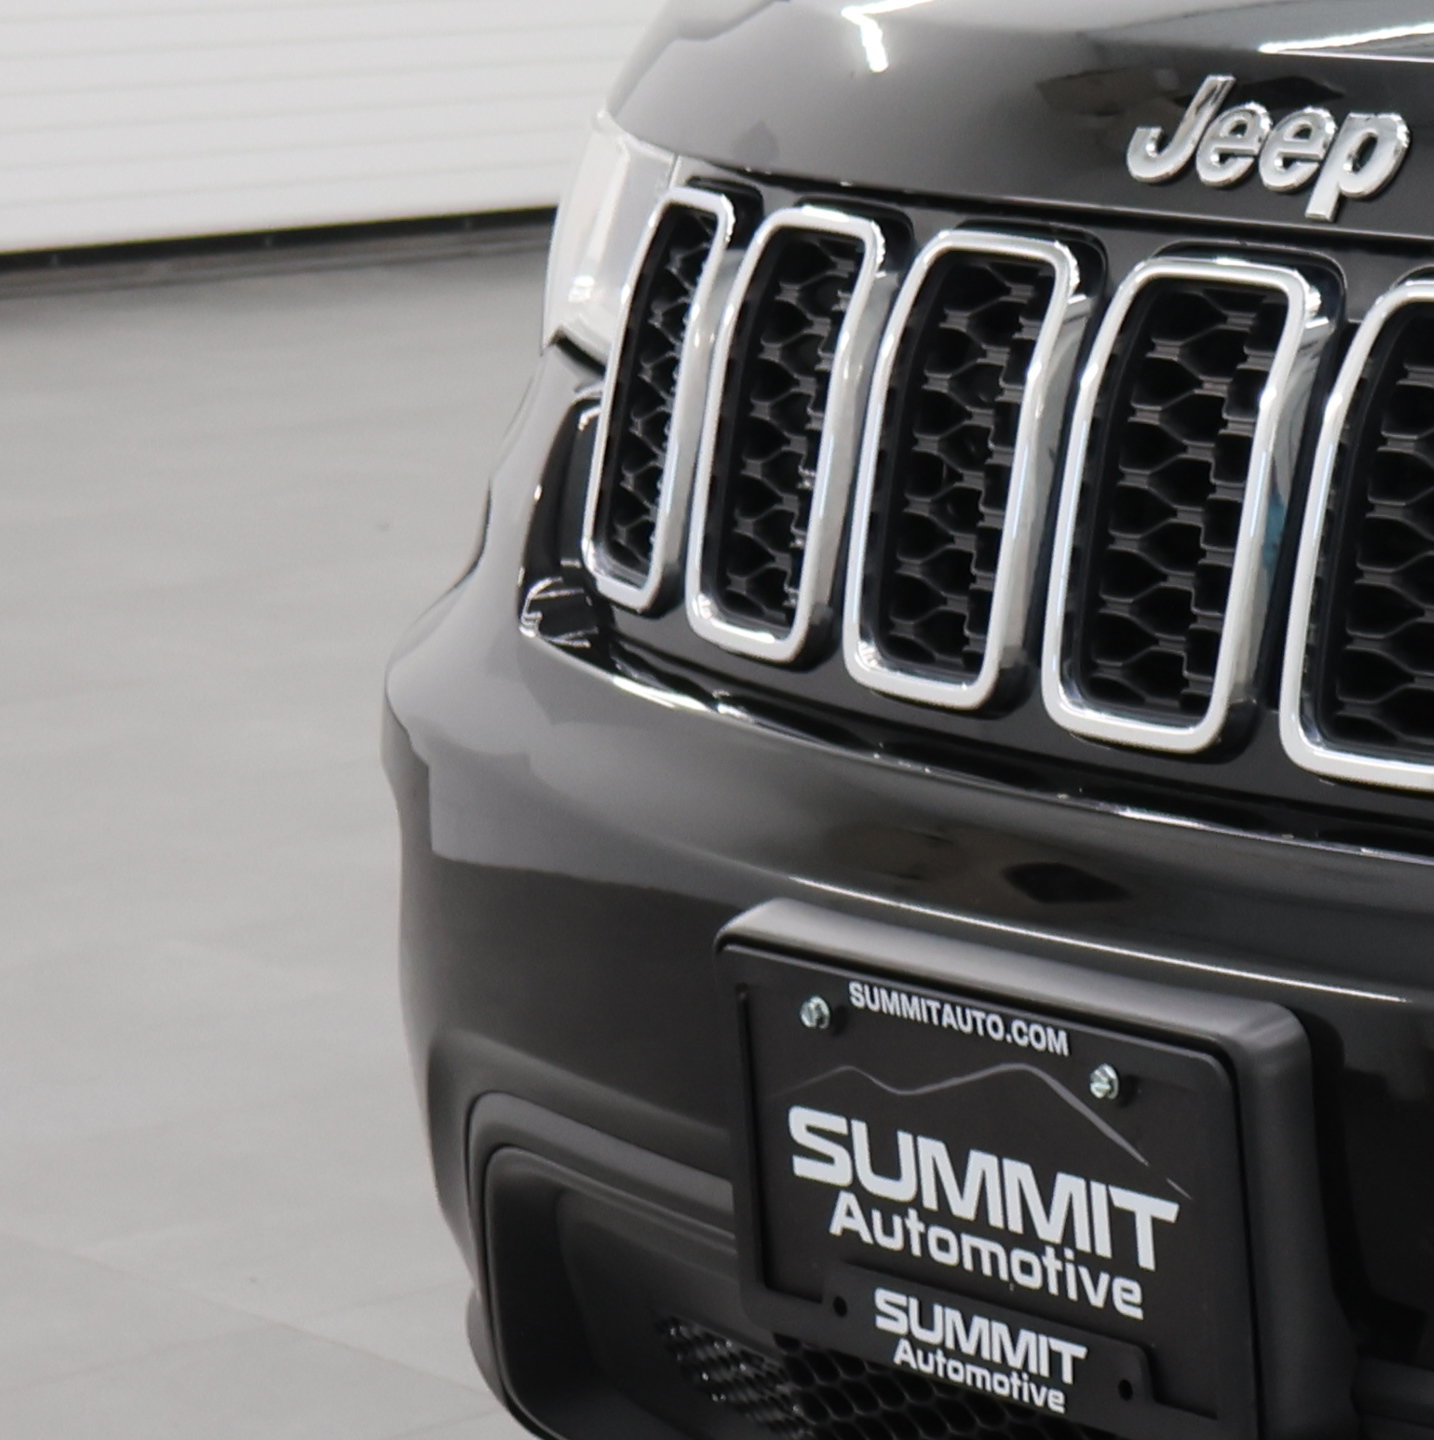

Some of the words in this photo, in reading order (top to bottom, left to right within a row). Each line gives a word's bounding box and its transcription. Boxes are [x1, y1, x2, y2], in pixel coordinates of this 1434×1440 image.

[1127, 74, 1410, 222] Jeep
[848, 981, 1069, 1056] SUMMITAUTO.COM
[788, 1106, 1180, 1271] SUMMIT
[829, 1190, 1144, 1320] Automotive
[874, 1287, 1087, 1385] SUMMIT
[893, 1338, 1065, 1414] Automotive
